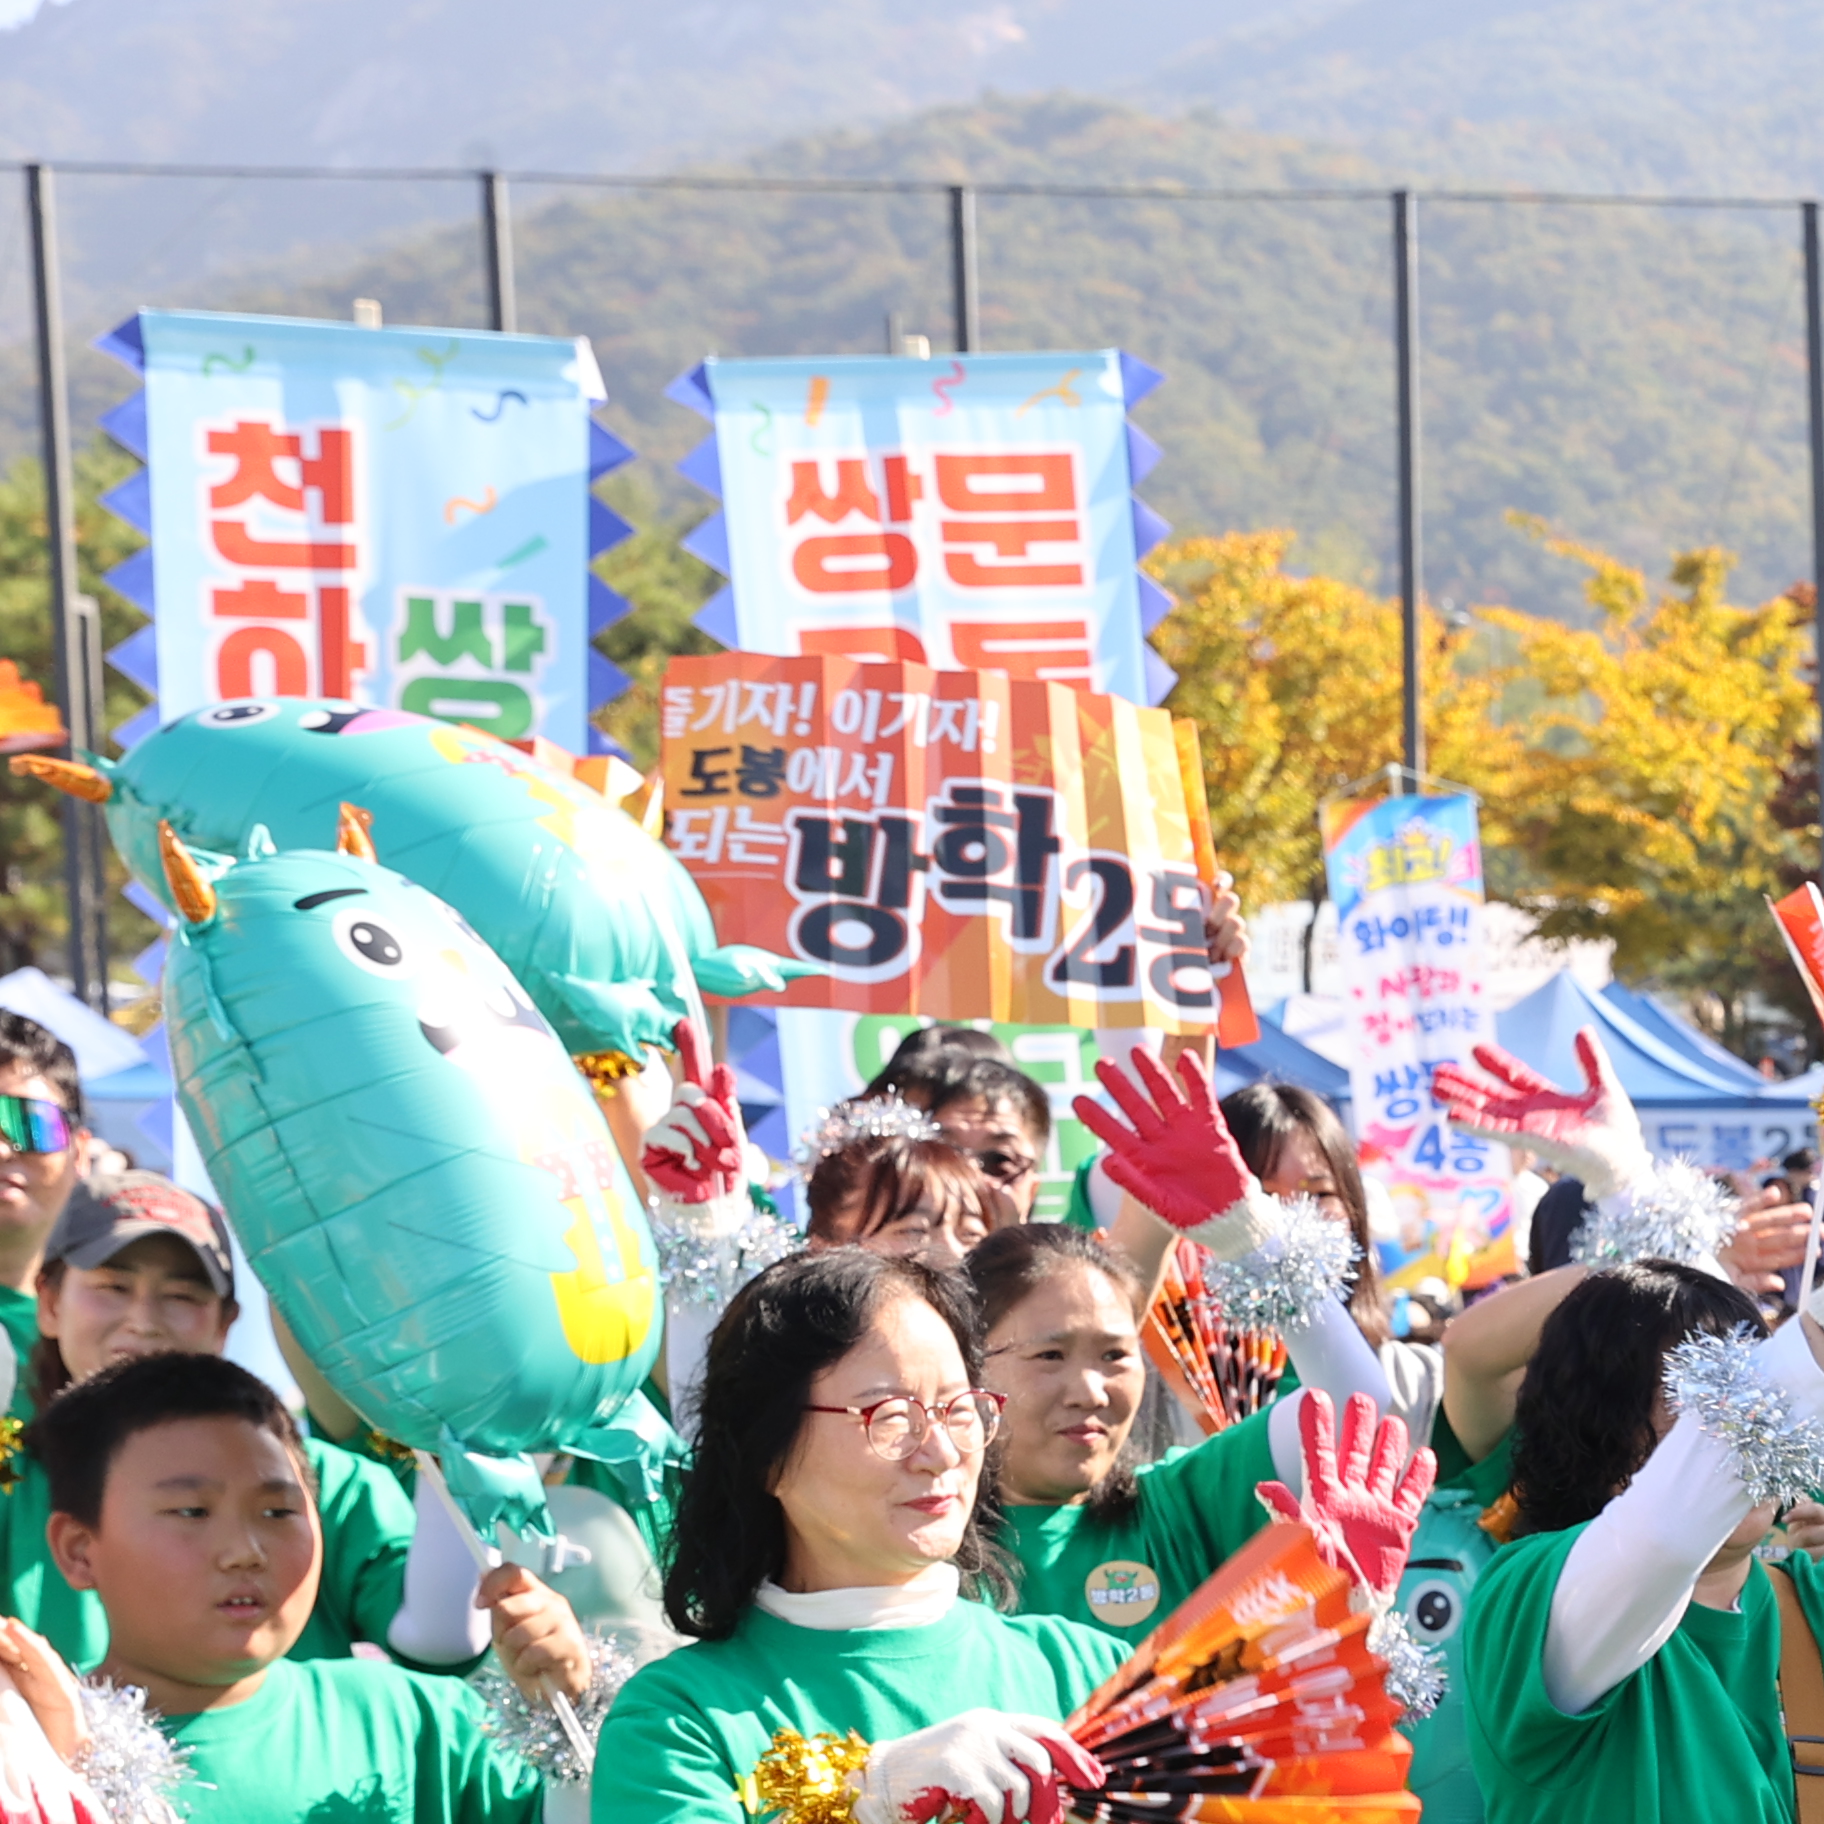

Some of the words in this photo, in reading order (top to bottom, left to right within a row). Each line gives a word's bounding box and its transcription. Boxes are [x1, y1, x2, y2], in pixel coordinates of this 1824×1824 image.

[786, 452, 1085, 593] 쌍문
[831, 688, 999, 754] 이기자!
[680, 744, 895, 806] 도봉에서
[671, 805, 788, 865] 되는
[792, 782, 1220, 1010] 방학2동
